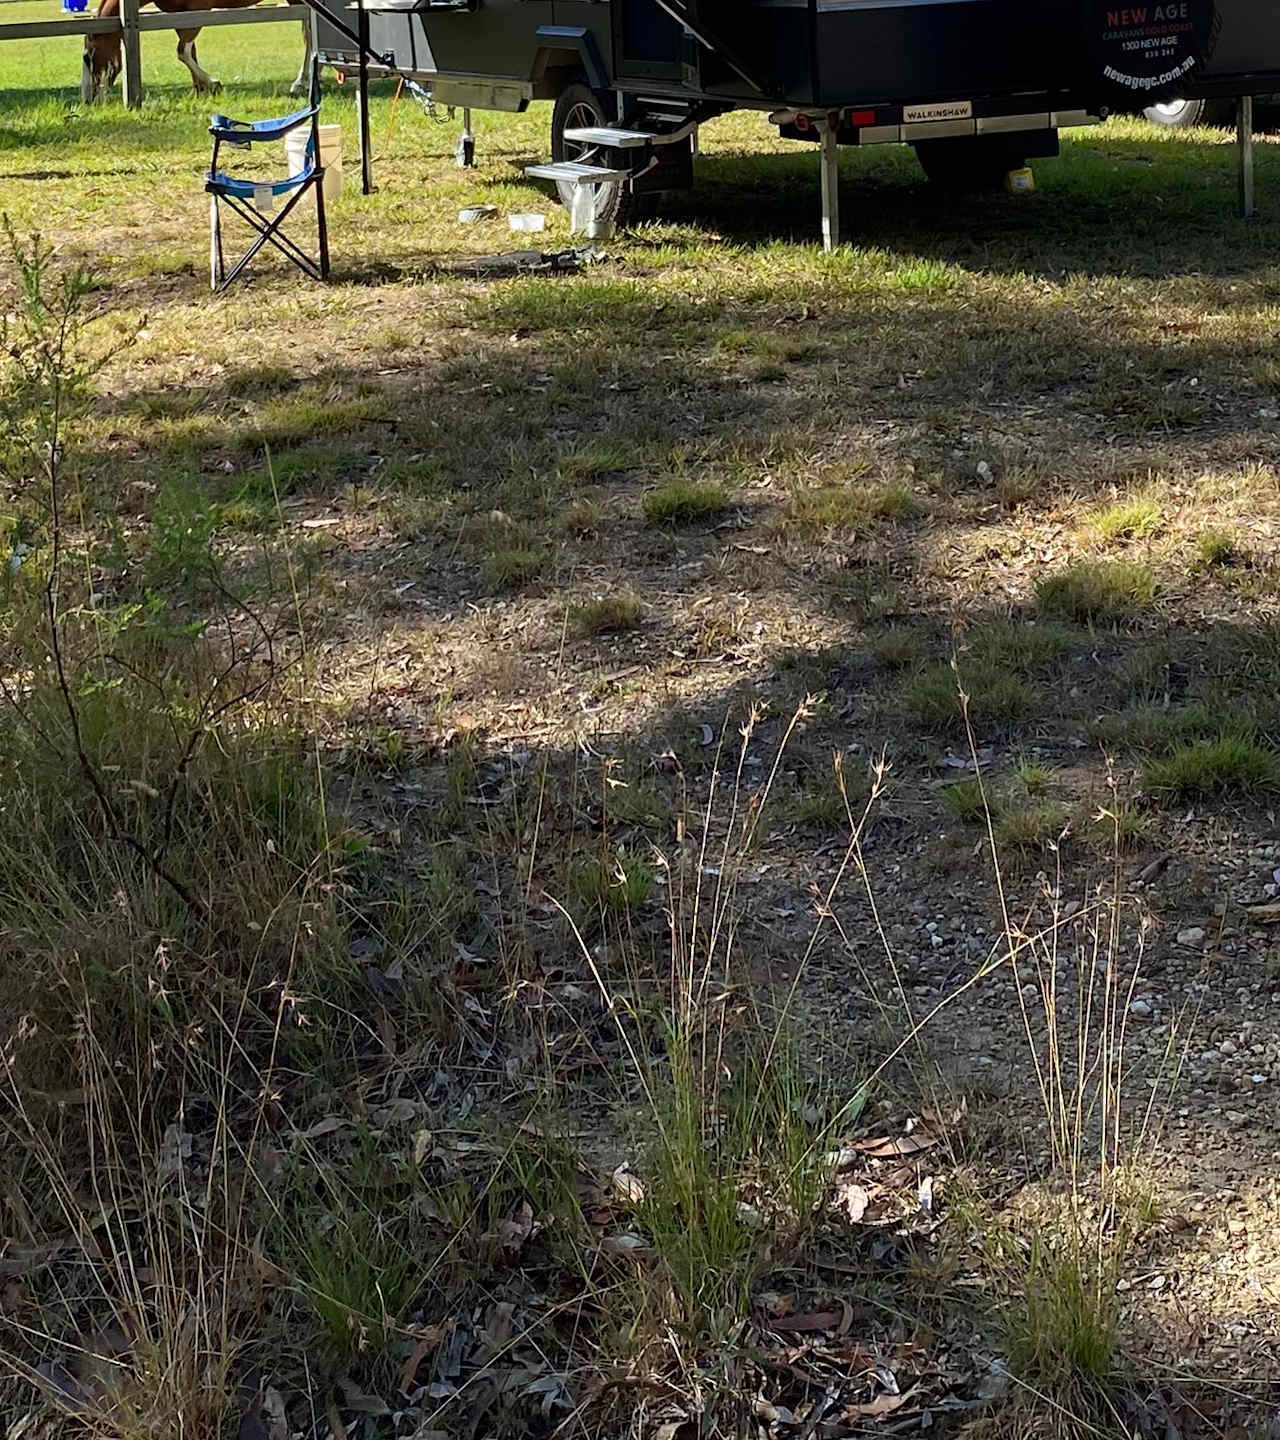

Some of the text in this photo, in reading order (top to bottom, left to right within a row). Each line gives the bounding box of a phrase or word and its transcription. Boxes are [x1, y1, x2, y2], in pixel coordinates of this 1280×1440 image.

[1107, 3, 1189, 27] NEW AGE
[1122, 39, 1140, 51] 1300
[1103, 55, 1196, 90] newagegc.com.au
[907, 108, 969, 120] WALKINSHAW
